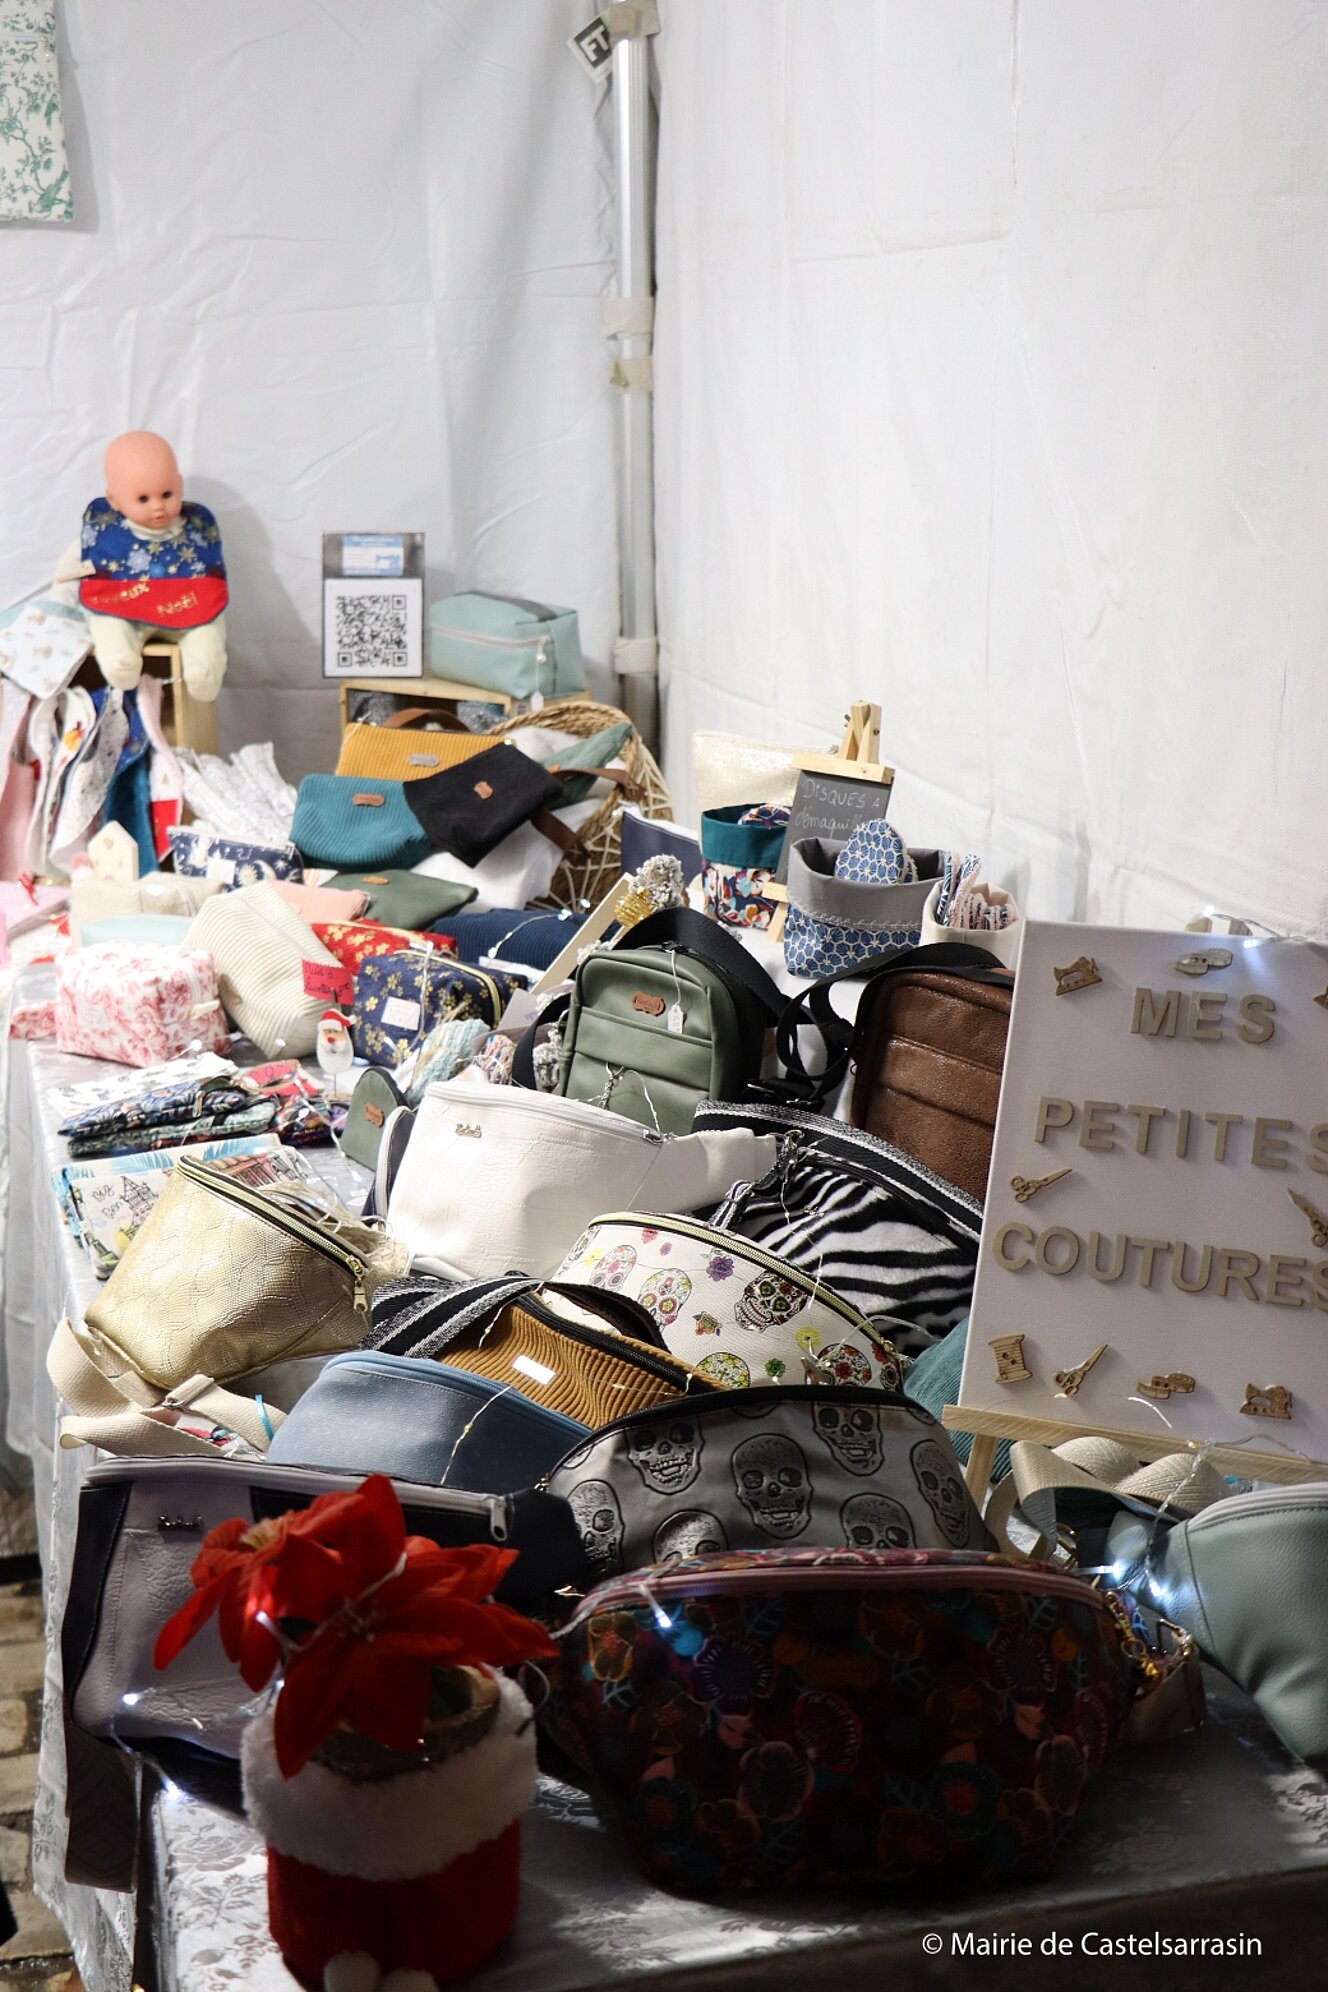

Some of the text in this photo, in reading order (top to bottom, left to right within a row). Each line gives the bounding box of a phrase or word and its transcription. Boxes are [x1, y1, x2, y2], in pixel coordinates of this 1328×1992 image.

[579, 25, 609, 62] FT
[1130, 987, 1276, 1044] MES
[1034, 1096, 1328, 1175] PETITES
